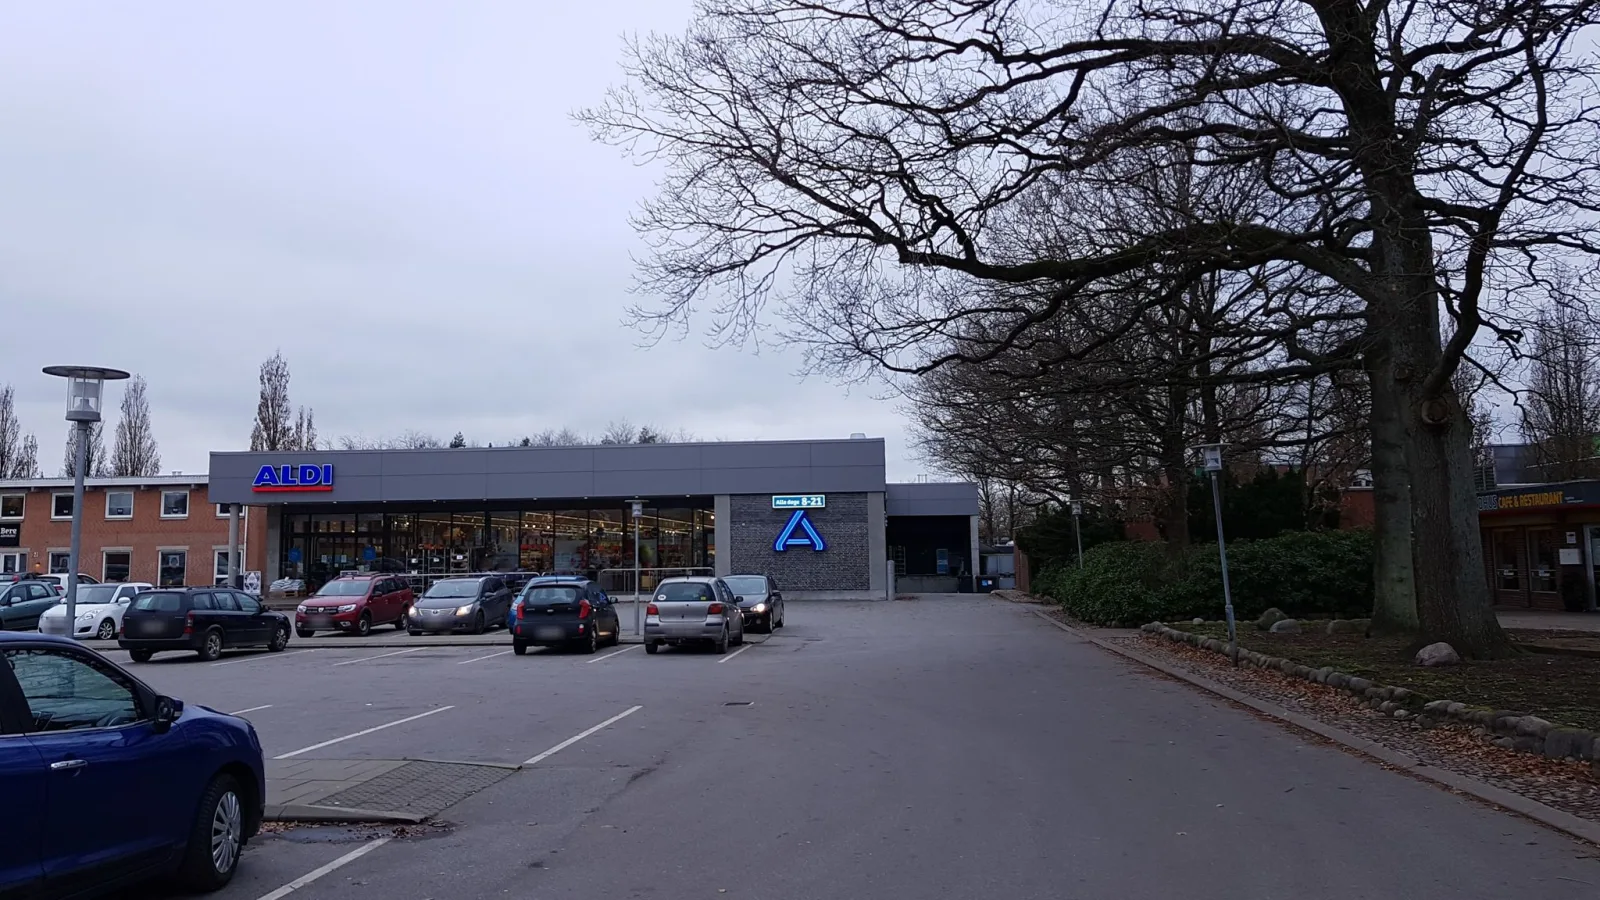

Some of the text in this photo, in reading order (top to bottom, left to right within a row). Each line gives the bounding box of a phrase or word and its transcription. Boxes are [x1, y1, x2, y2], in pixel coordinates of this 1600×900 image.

[251, 463, 333, 486] ALDI
[801, 497, 822, 506] 8-21
[1519, 491, 1564, 507] RESTAURANT
